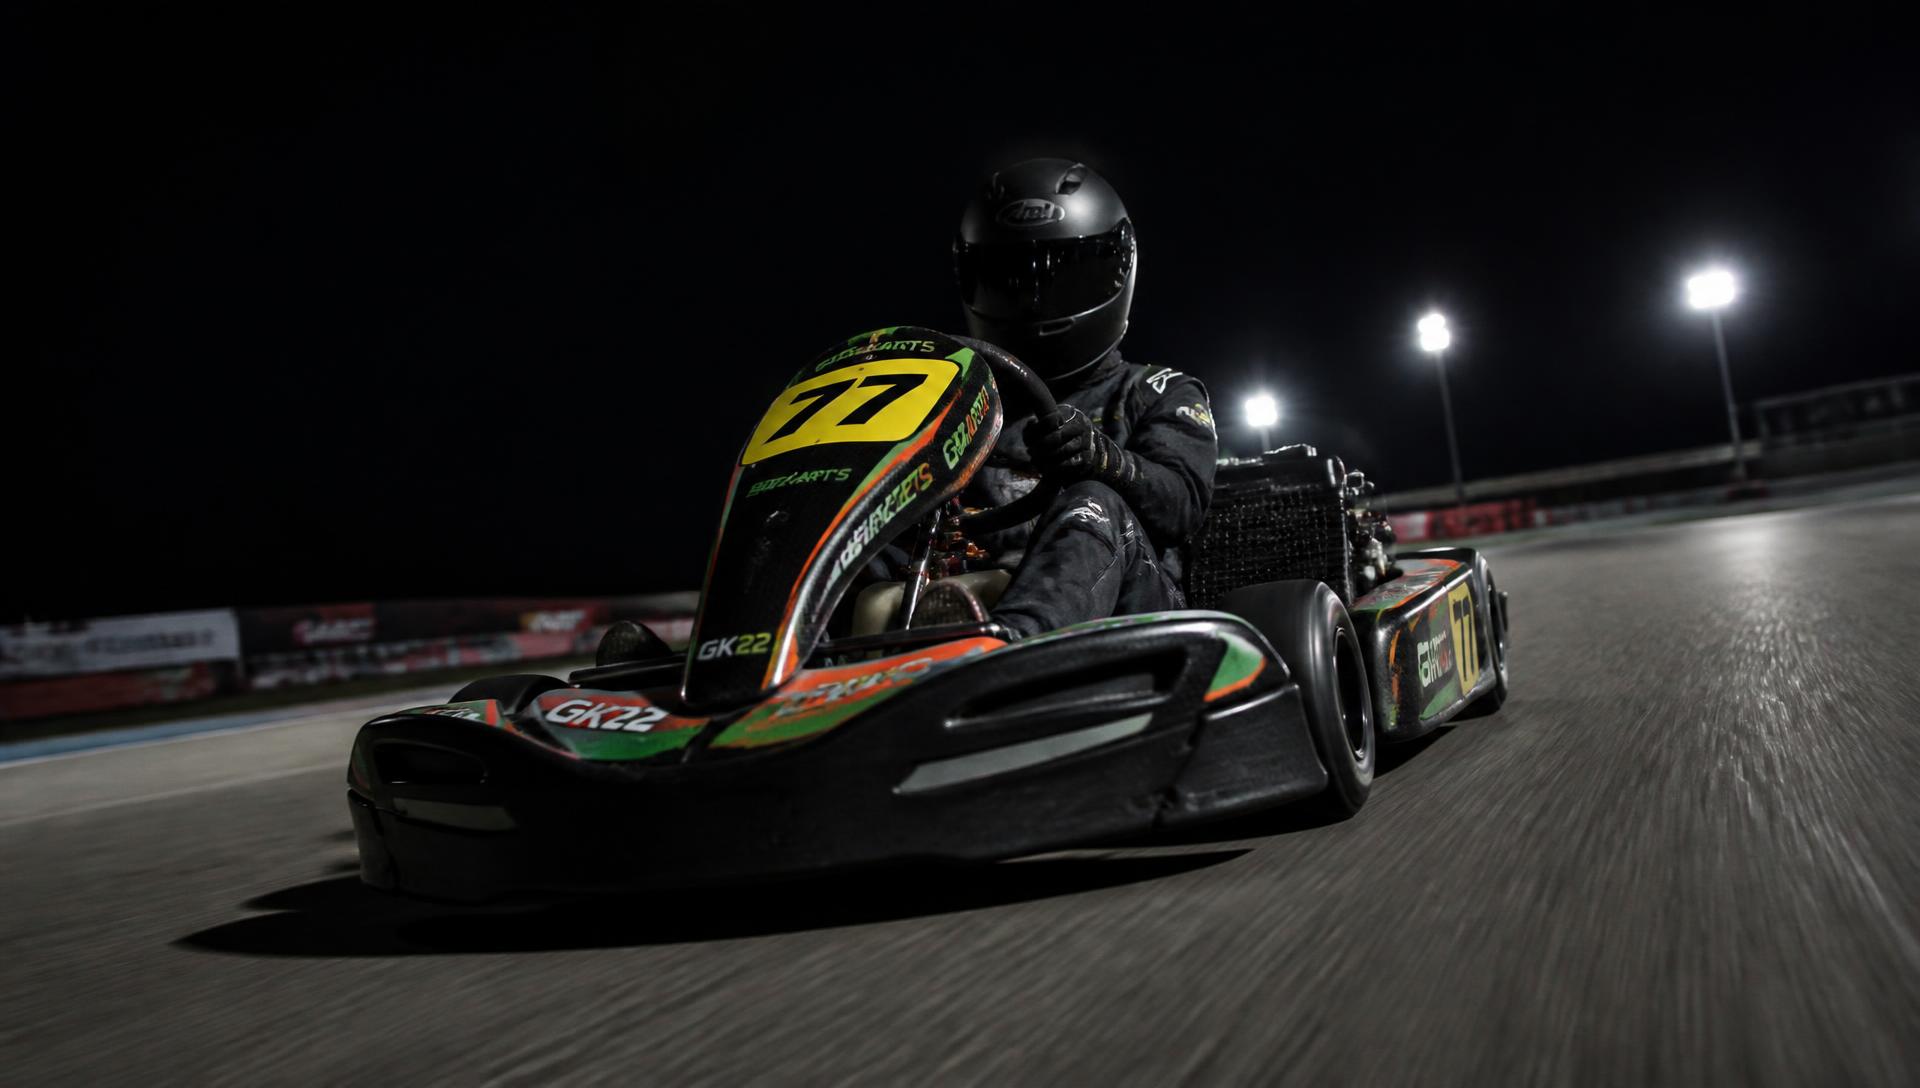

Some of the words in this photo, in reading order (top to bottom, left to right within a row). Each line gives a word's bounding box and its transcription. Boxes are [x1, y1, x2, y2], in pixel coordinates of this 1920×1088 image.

[764, 374, 928, 444] 77
[696, 632, 773, 660] GK22
[1453, 597, 1475, 682] 77
[544, 698, 670, 733] GK22
